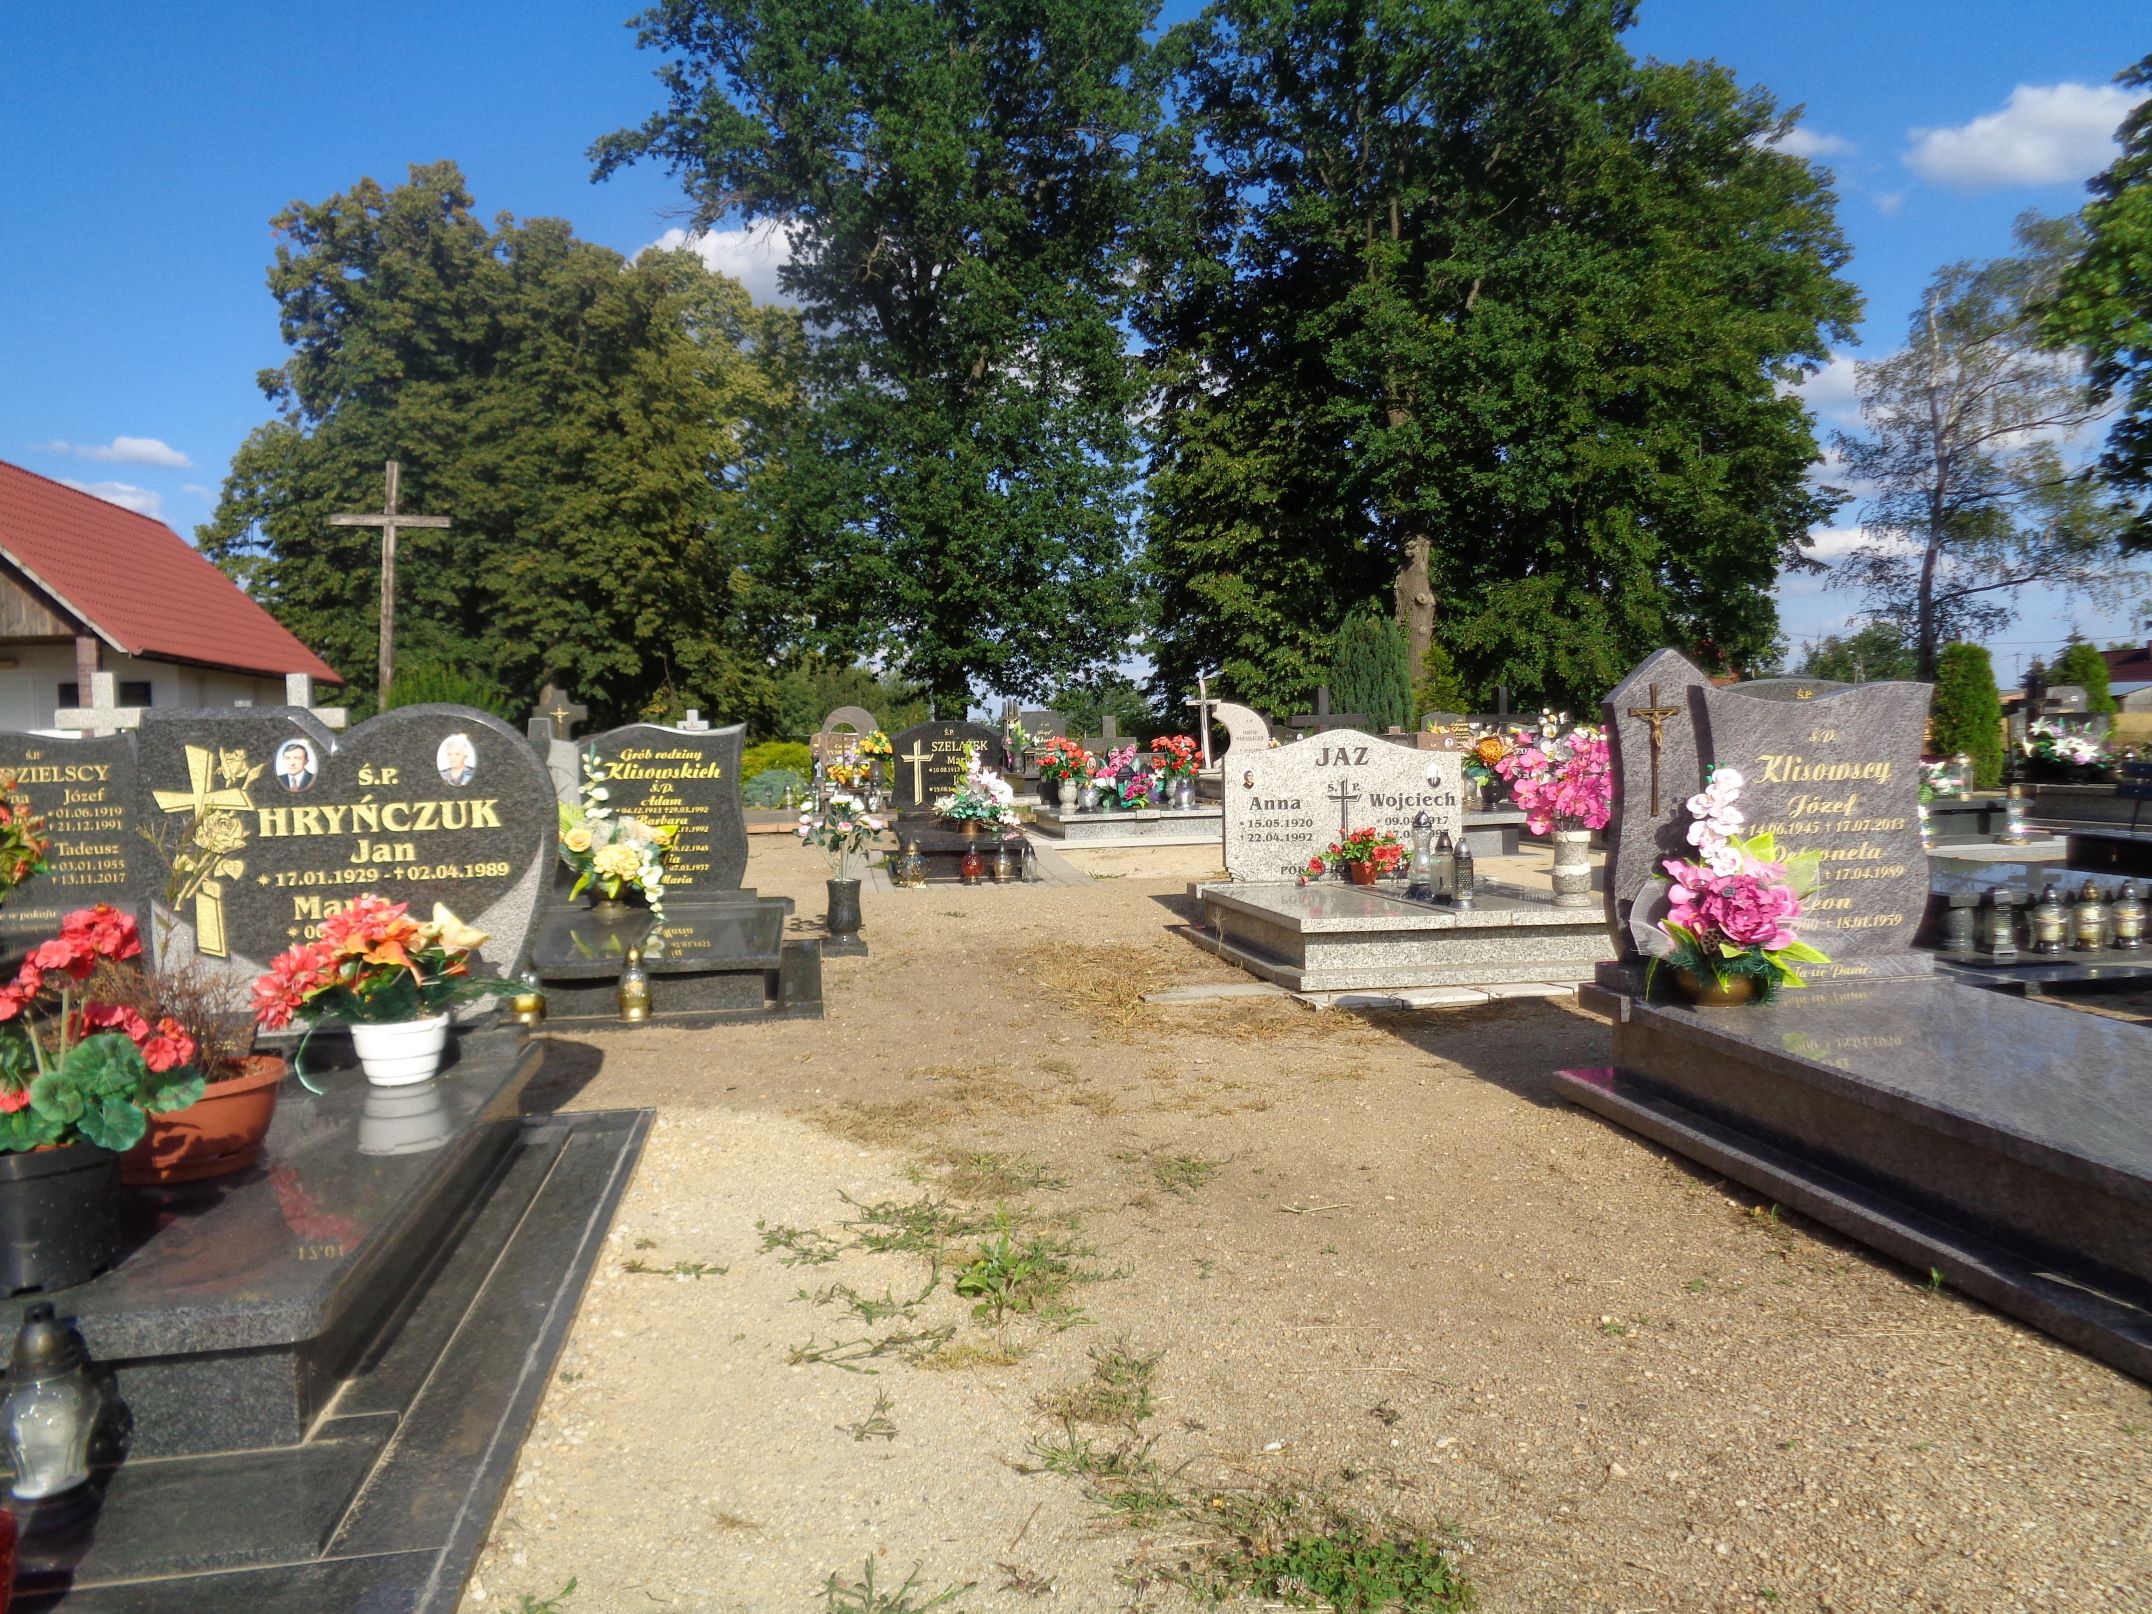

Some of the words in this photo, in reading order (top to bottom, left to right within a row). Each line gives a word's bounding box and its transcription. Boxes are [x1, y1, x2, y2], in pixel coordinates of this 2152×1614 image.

[620, 748, 652, 761] Grób
[655, 748, 702, 761] rodziny
[1316, 747, 1370, 767] JAZ
[603, 762, 721, 780] Klisowskich
[1752, 754, 1894, 785] Klisowscy
[63, 788, 104, 805] Józef
[1249, 796, 1301, 811] Anna
[1369, 791, 1456, 811] Wojciech
[55, 807, 122, 819] 01.06.1919
[1787, 795, 1859, 819] Józef
[257, 794, 502, 838] HRYŃCZUK
[636, 814, 689, 826] Barbara
[1248, 818, 1313, 828] 15.05.1920
[57, 820, 122, 832] 21.12.1991
[1247, 832, 1313, 842] 22.04.1992
[55, 841, 119, 857] Tadeusz
[350, 838, 417, 864] Jan
[59, 860, 125, 872] 03.01.1955
[275, 869, 379, 887] 17.01.1929
[407, 862, 510, 881] 02.04.1989
